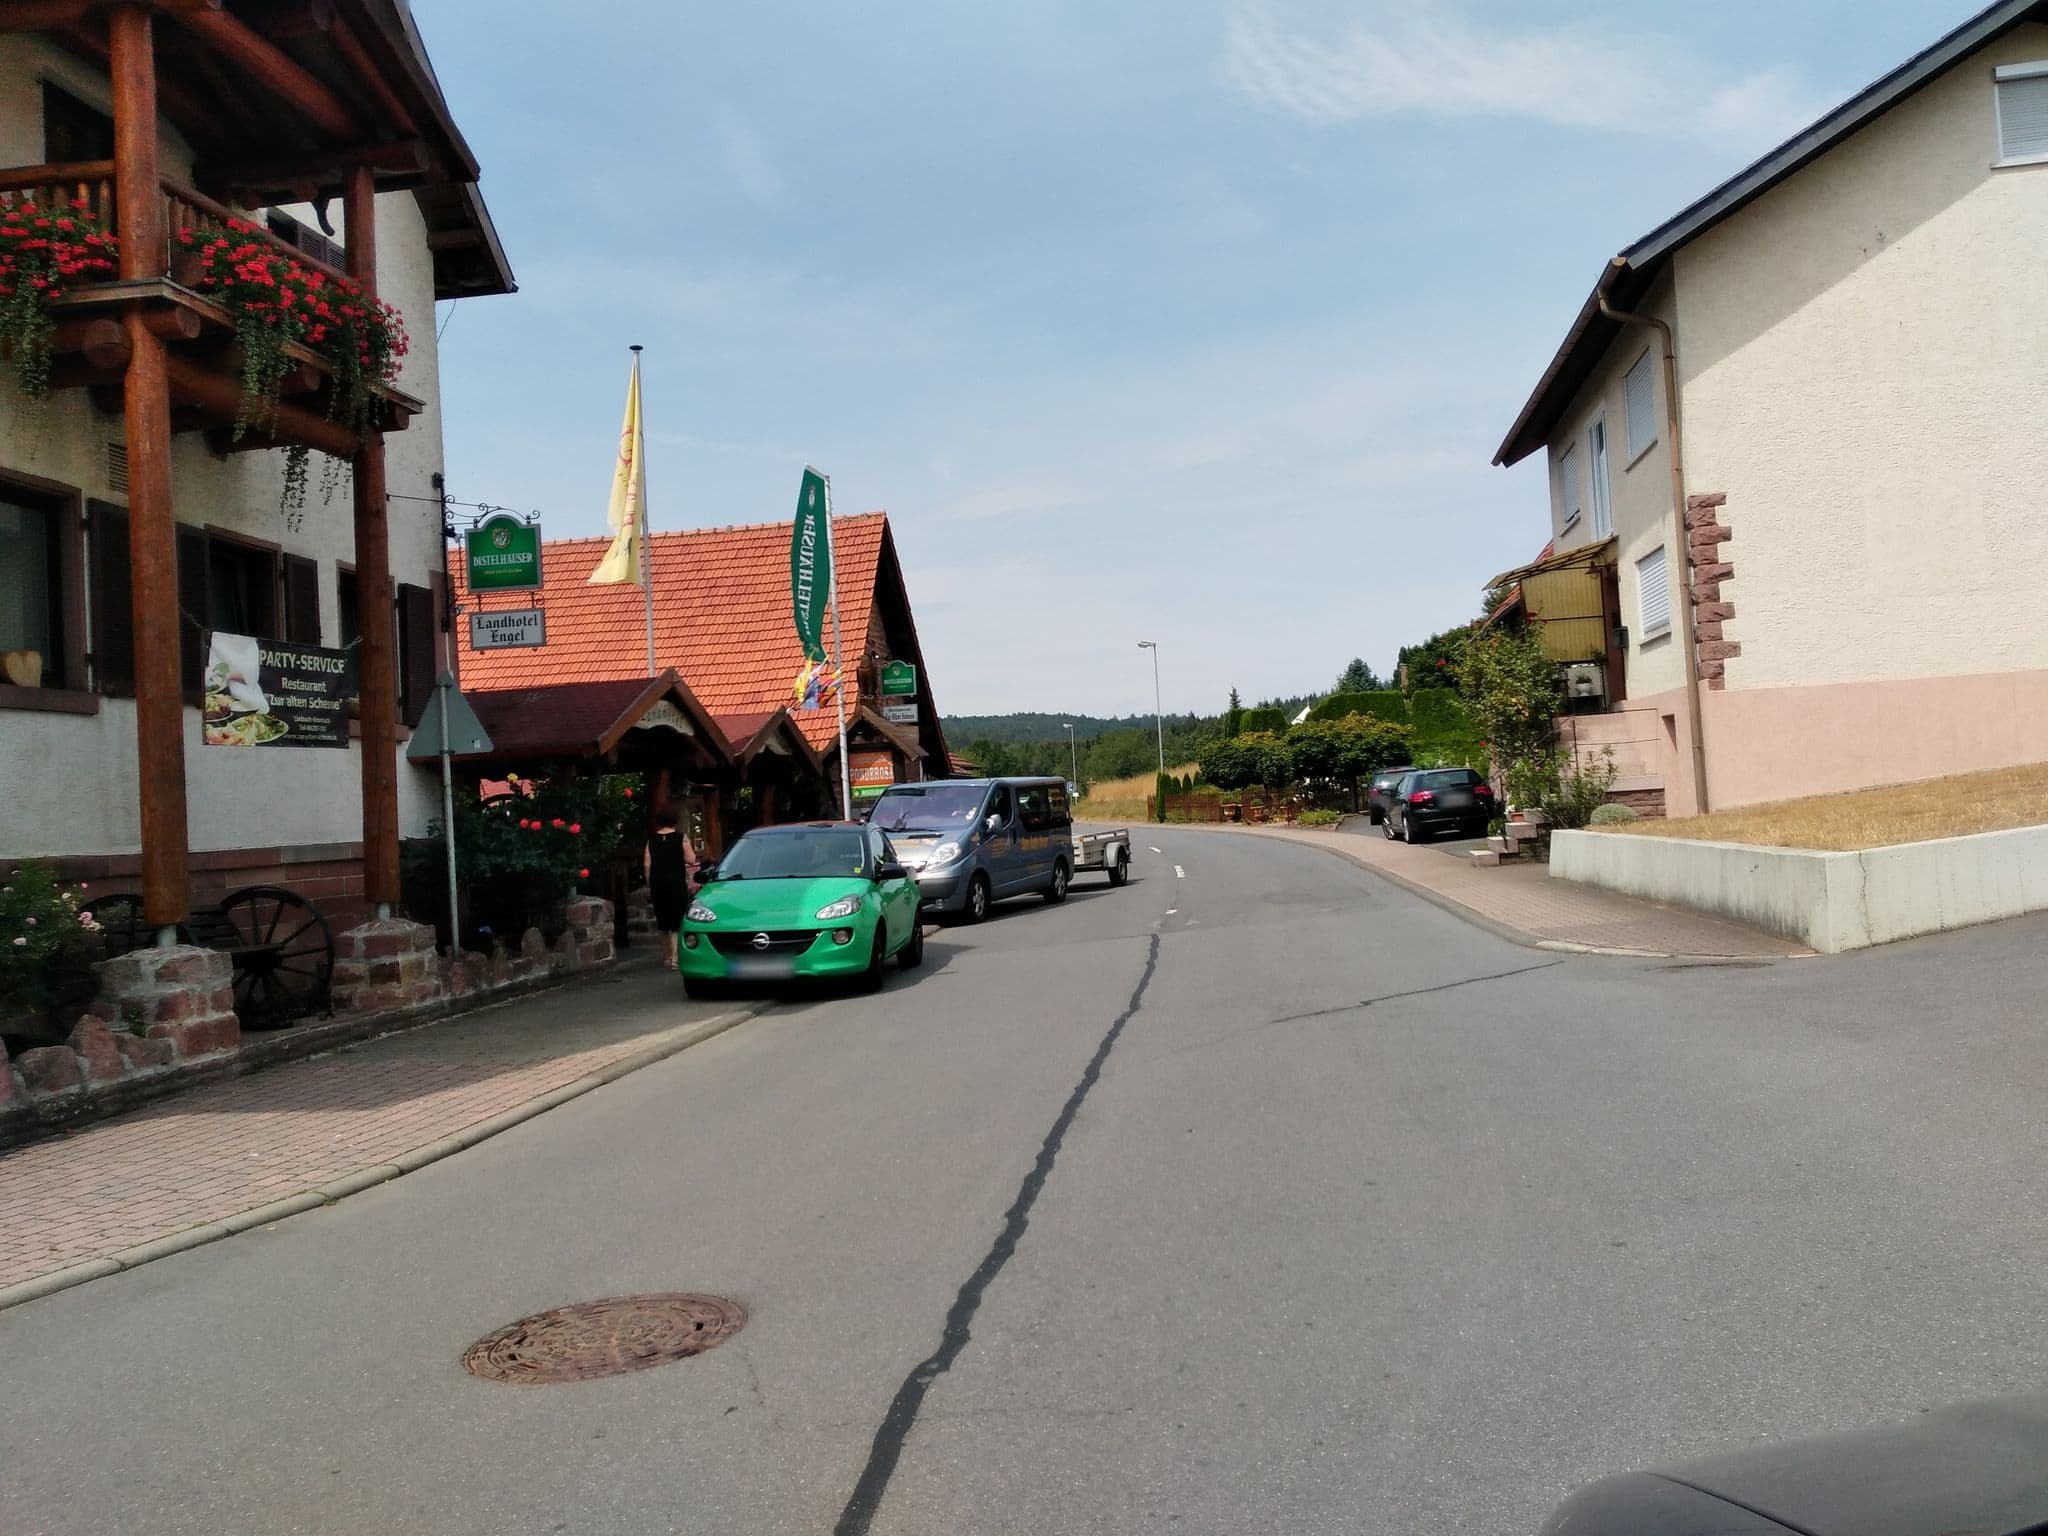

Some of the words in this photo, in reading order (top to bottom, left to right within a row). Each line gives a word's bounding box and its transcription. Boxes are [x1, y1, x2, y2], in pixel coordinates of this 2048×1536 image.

[476, 614, 538, 630] Landhotel
[490, 629, 525, 645] Engel
[259, 649, 345, 674] PARTY-SERVICE
[281, 677, 327, 693] Restaurant
[286, 695, 307, 708] alten
